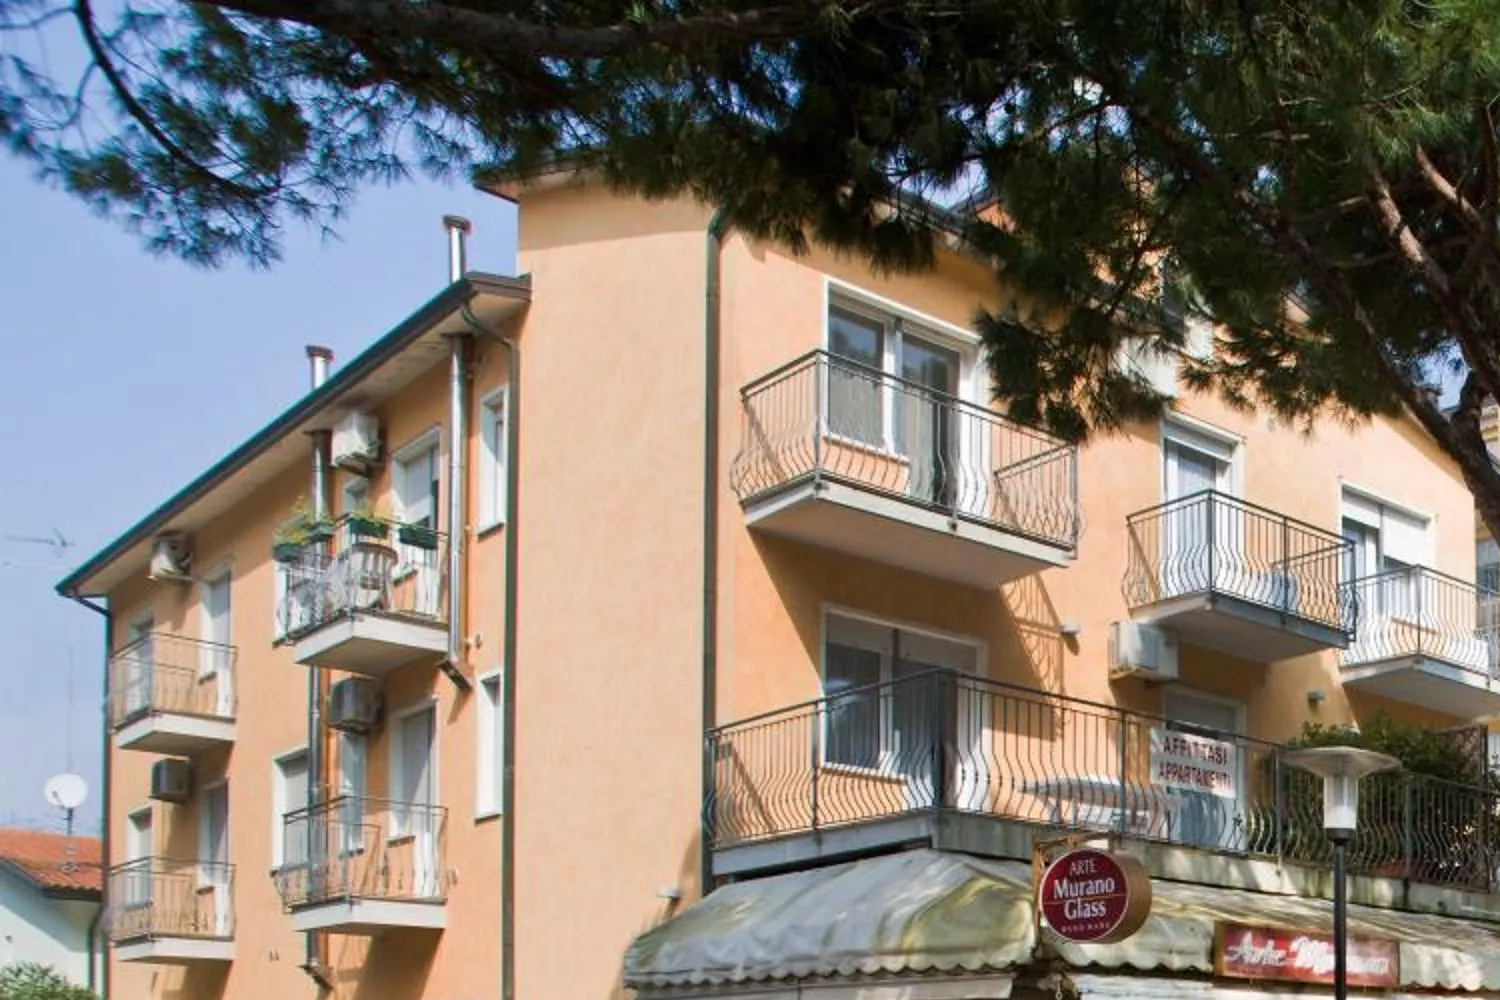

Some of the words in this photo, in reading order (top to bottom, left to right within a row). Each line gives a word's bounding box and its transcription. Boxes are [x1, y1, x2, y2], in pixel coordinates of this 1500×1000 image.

[1069, 859, 1097, 877] ARTE
[1053, 877, 1115, 900] Murano
[1063, 898, 1107, 920] Glass
